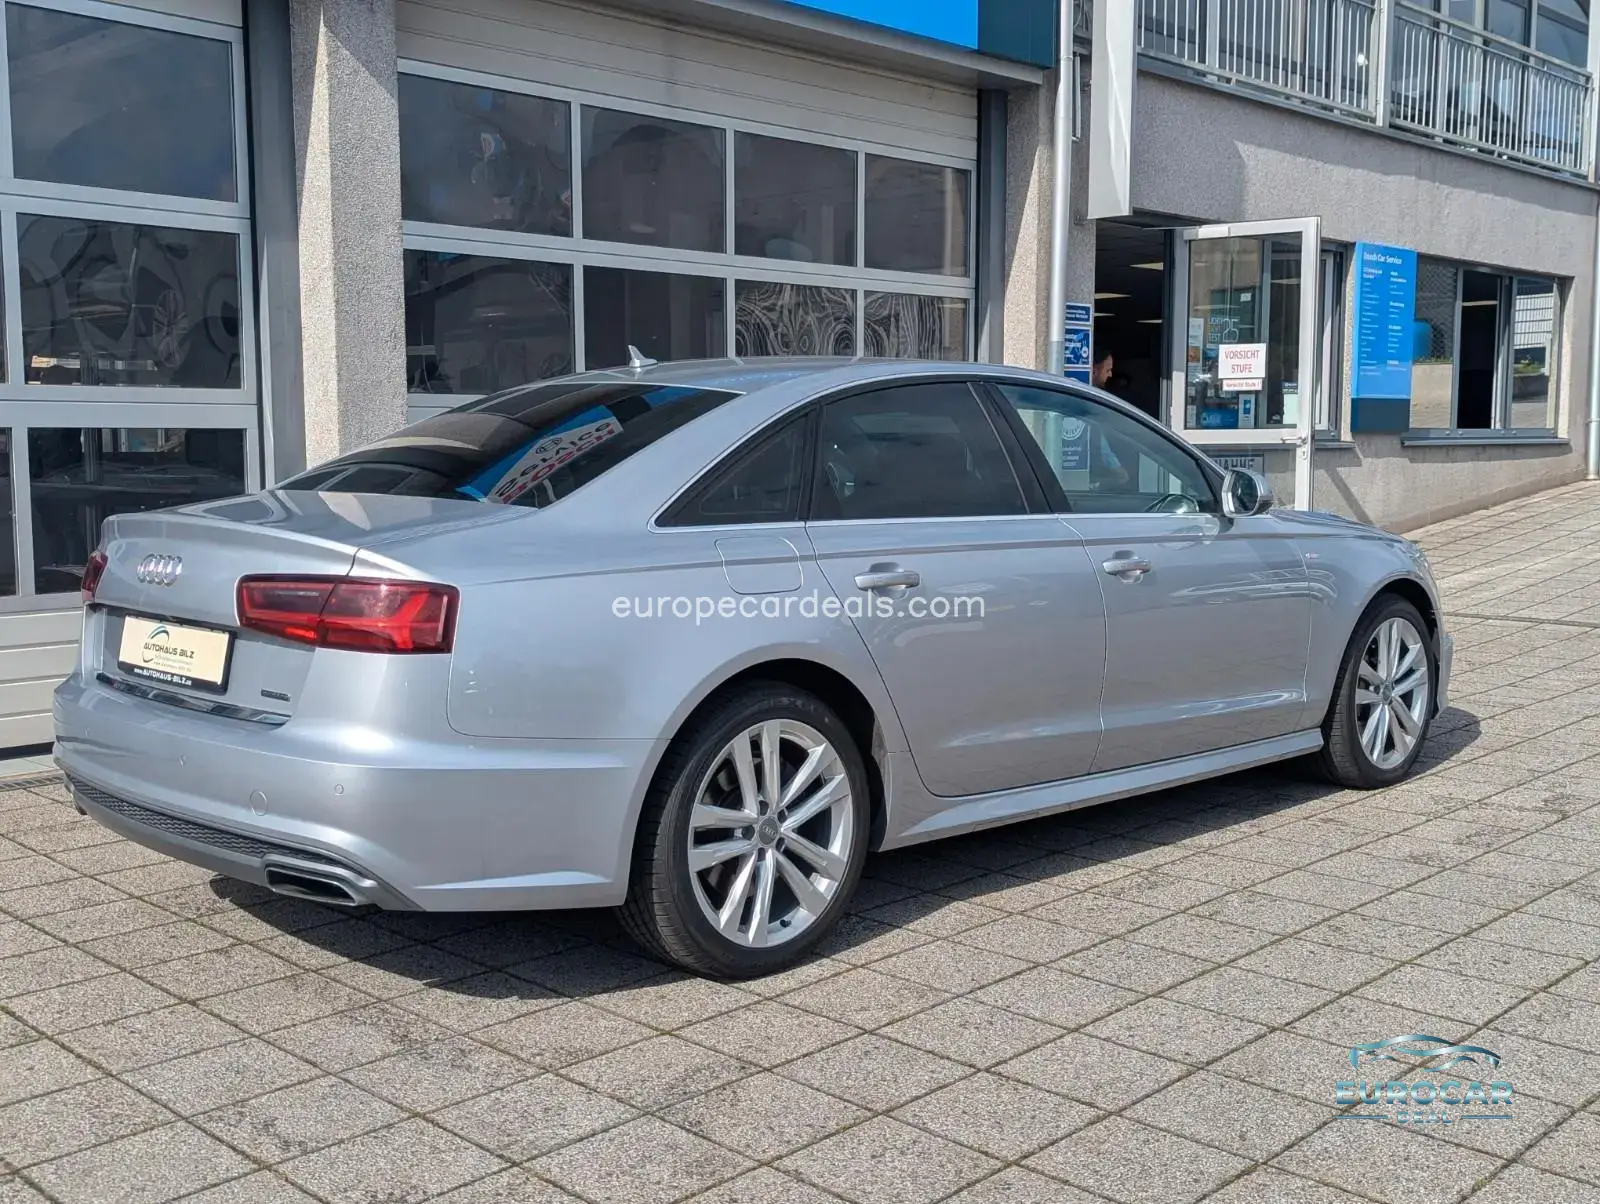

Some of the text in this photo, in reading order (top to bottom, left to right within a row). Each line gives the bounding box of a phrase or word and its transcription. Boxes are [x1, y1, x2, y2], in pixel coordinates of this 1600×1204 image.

[1378, 254, 1386, 263] Car
[1386, 255, 1402, 265] Service
[1224, 349, 1261, 360] VORSICHT
[1231, 363, 1253, 374] STUFE
[143, 641, 195, 659] AUTOHAUS BILZ
